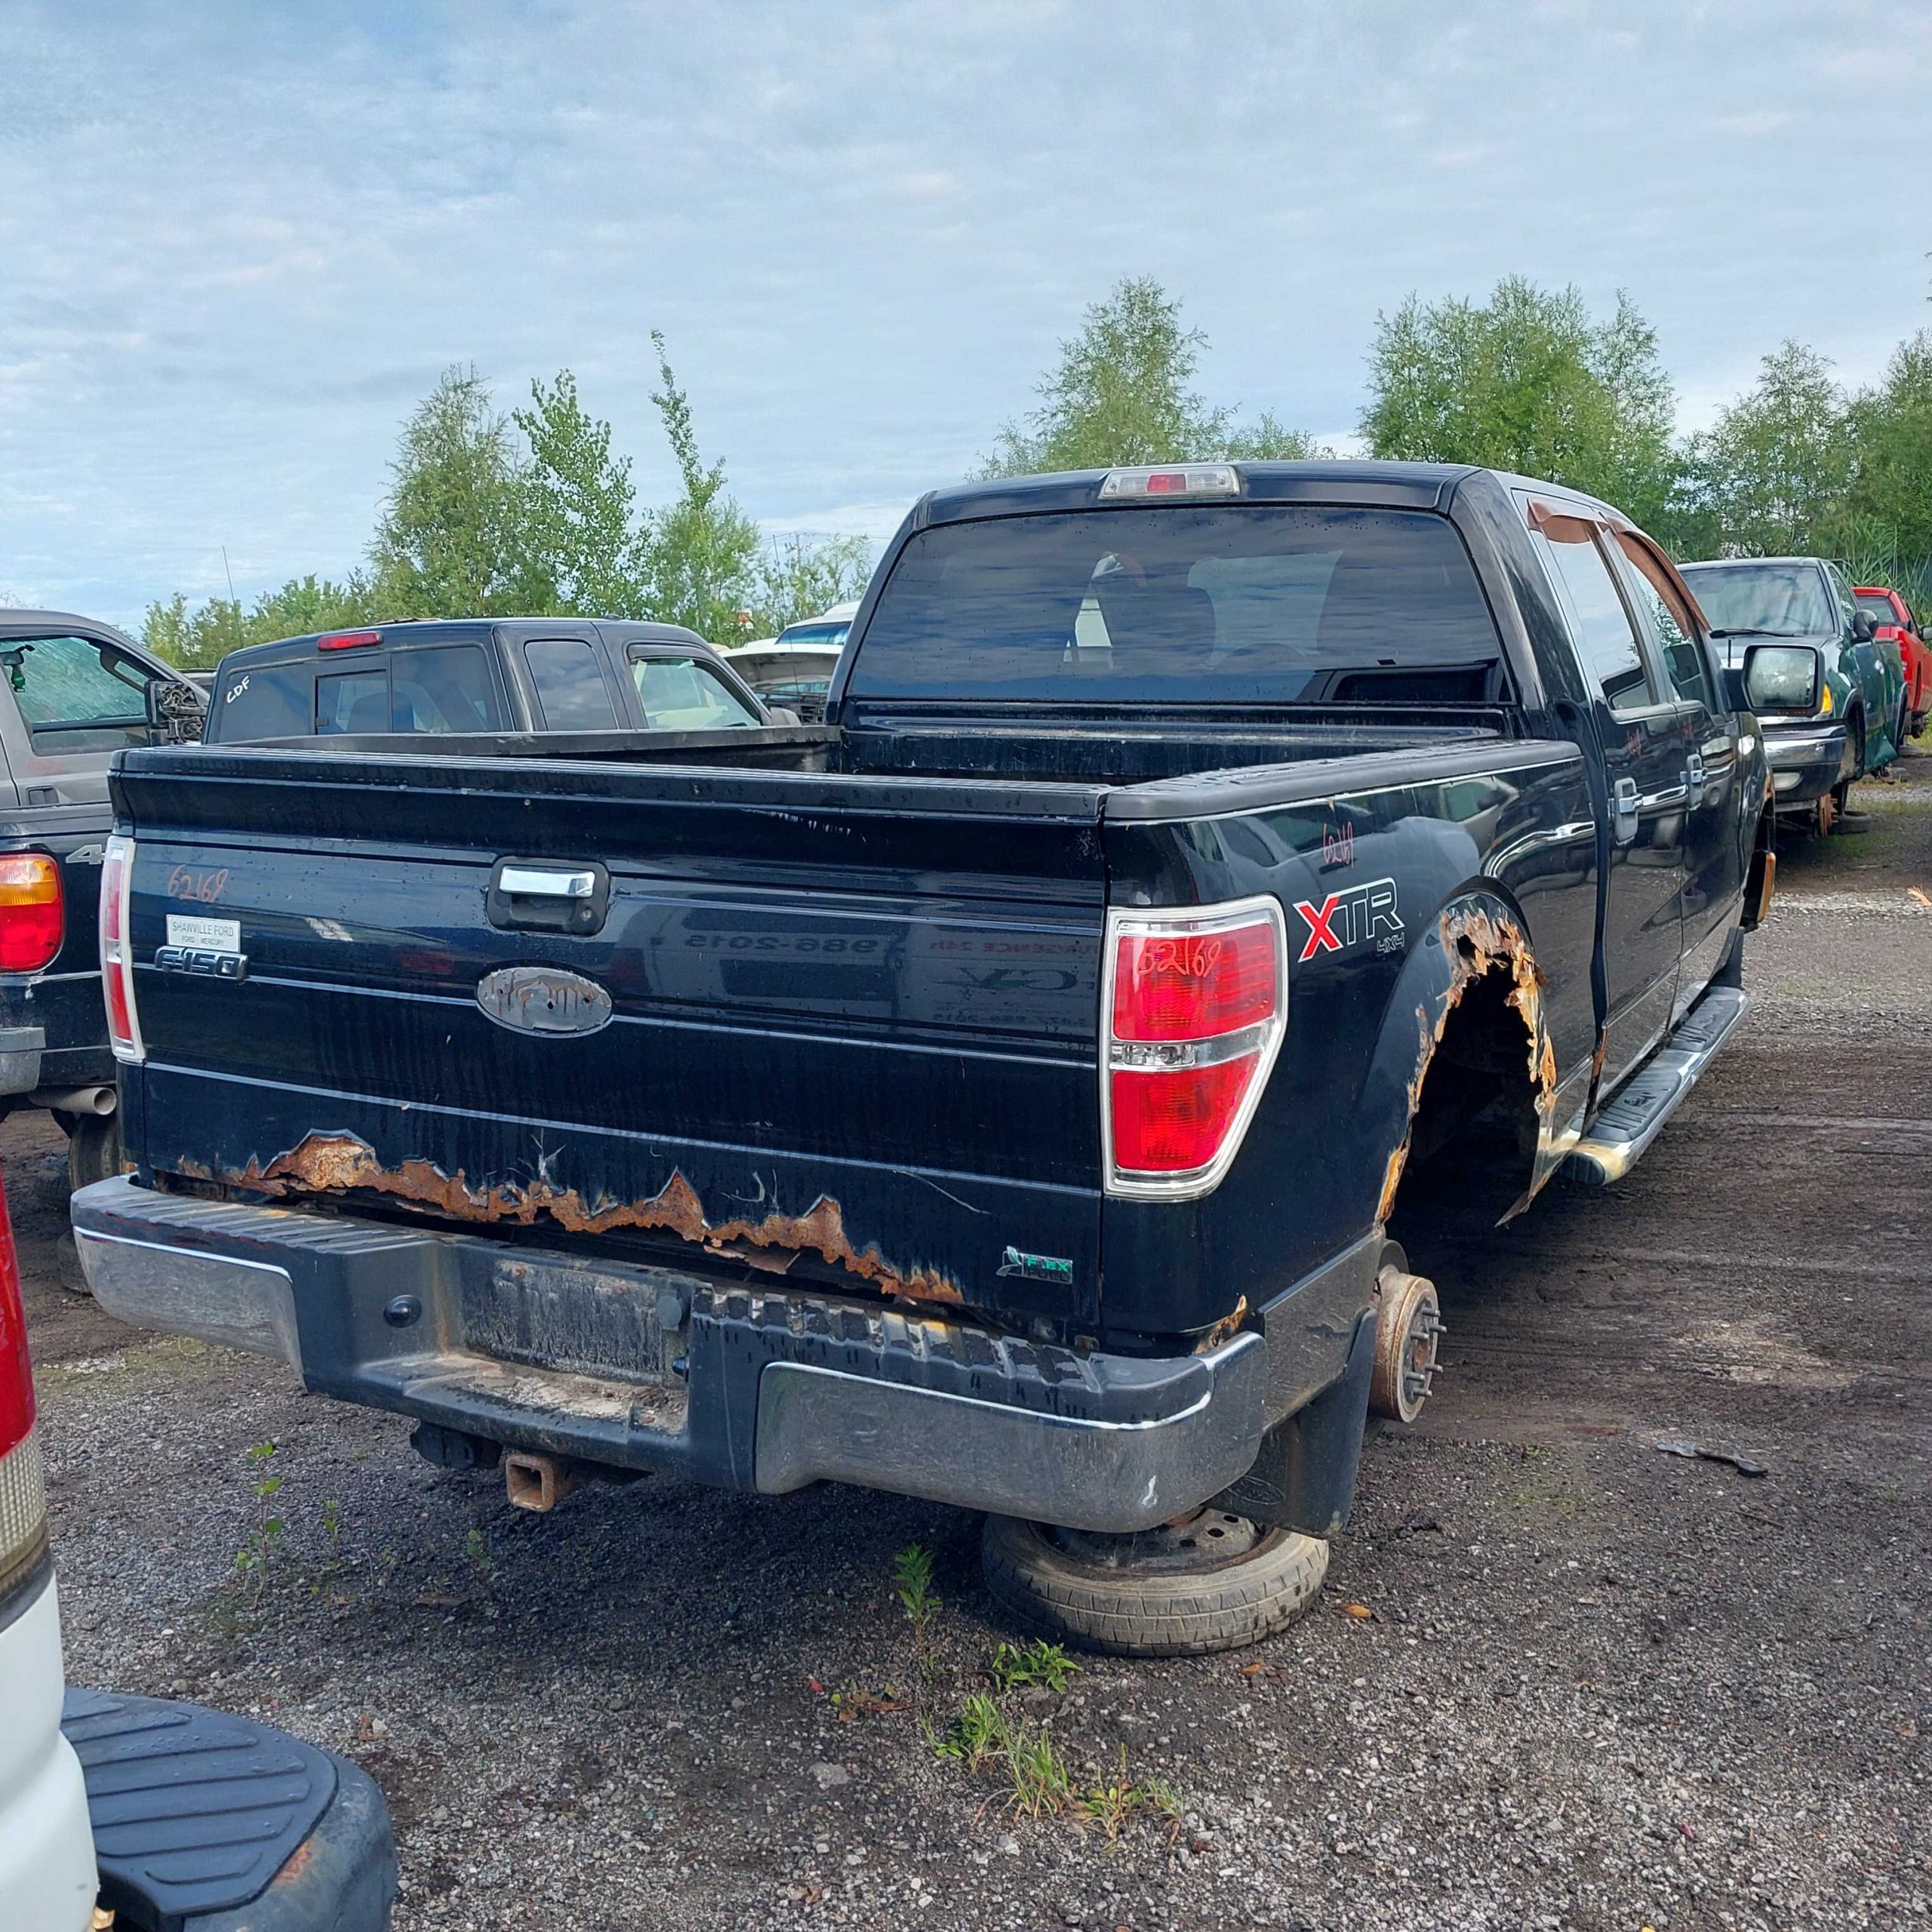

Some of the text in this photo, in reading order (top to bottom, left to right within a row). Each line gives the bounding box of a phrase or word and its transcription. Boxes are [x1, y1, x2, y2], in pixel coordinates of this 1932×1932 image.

[227, 675, 250, 703] CDF
[172, 921, 234, 937] SHAWVILLE FORD
[1292, 877, 1405, 963] XTR
[182, 935, 195, 943] FORD
[201, 937, 223, 946] MERCURY
